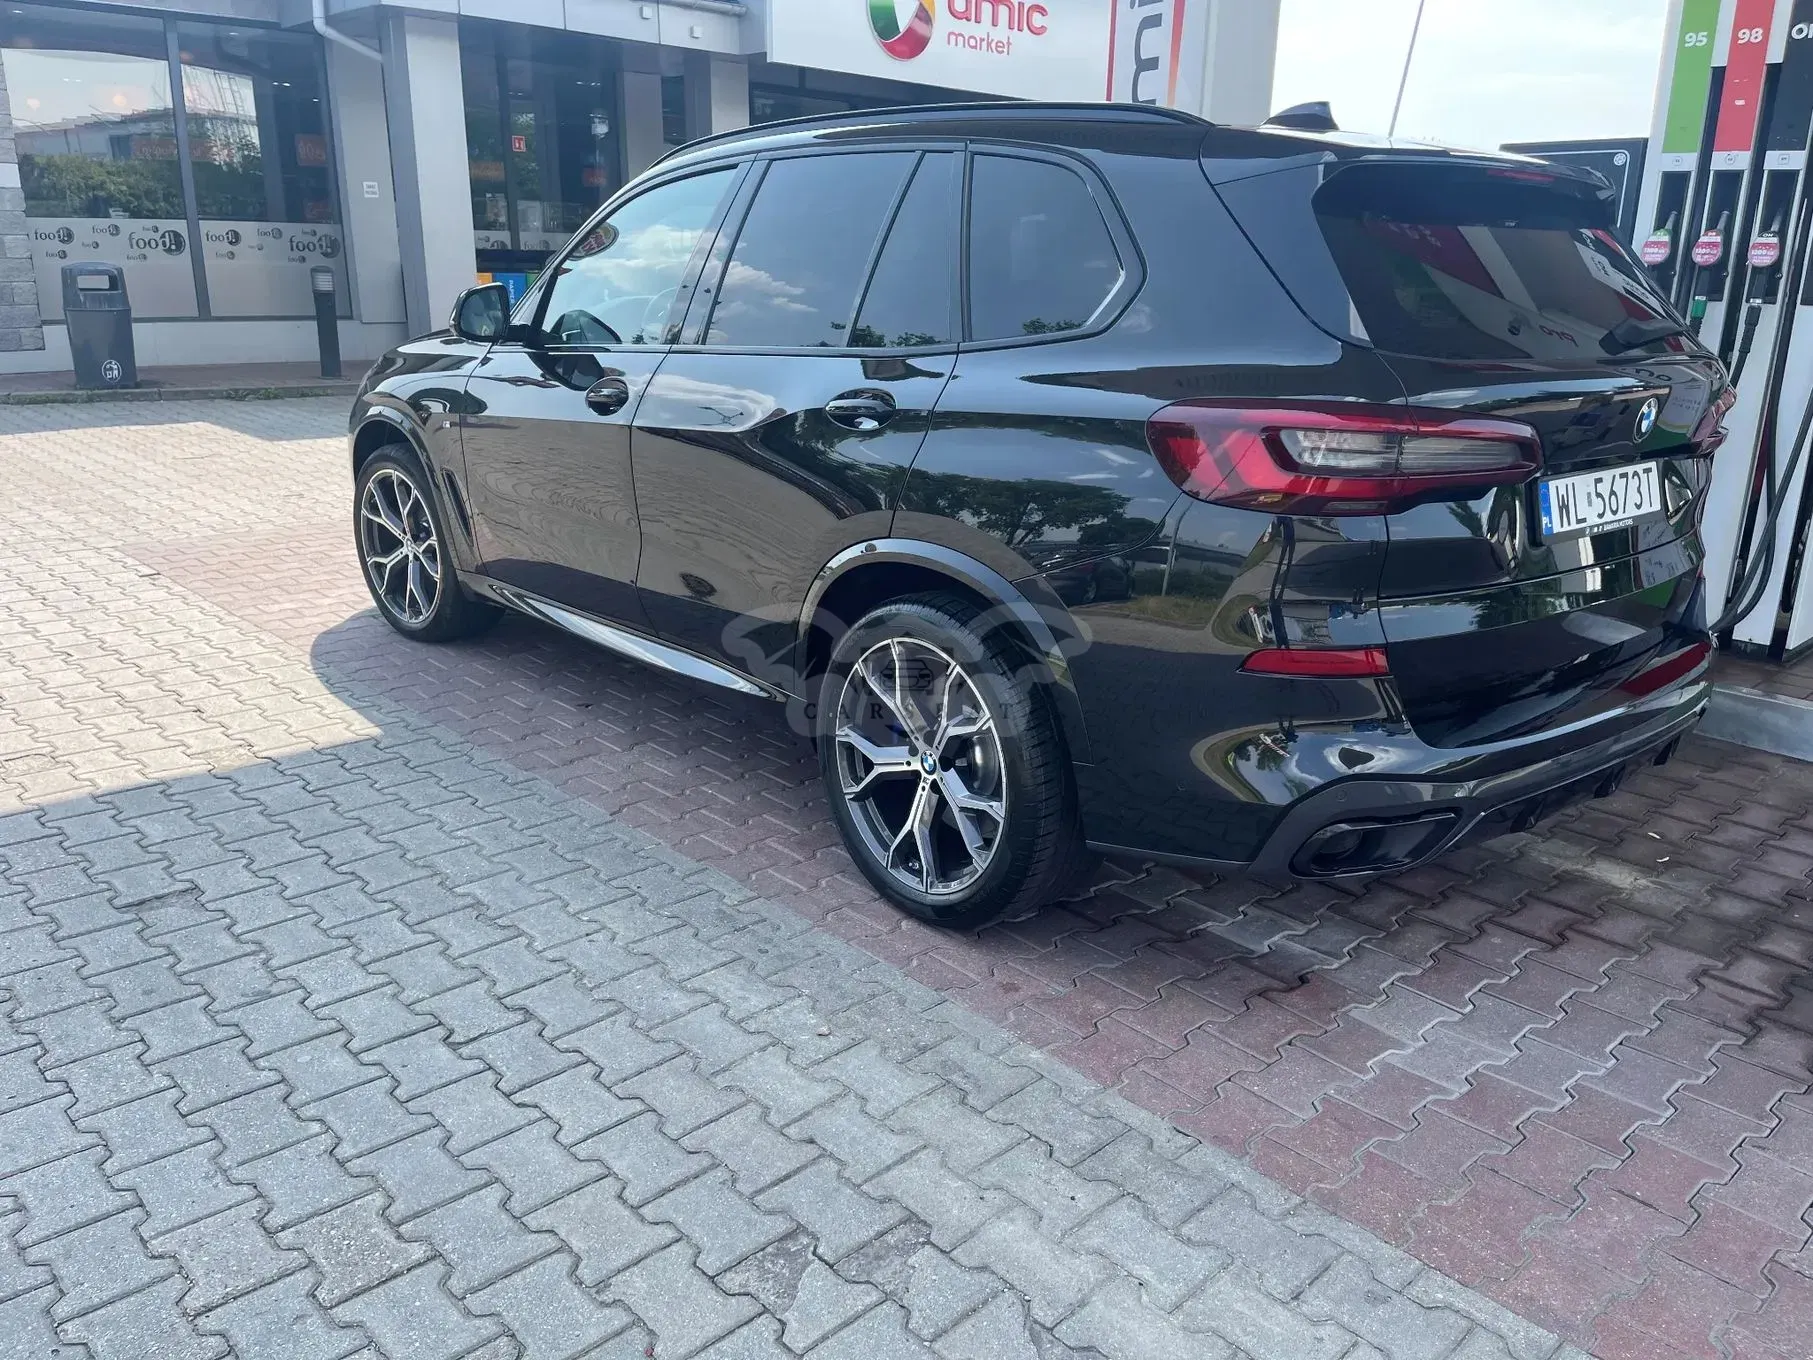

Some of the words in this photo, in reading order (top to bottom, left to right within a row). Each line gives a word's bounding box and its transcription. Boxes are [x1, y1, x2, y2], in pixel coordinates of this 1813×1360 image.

[947, 31, 1012, 56] market
[1684, 32, 1708, 47] 95
[1737, 27, 1763, 44] 98
[1556, 482, 1587, 529] WL
[1594, 467, 1653, 519] 5673T
[1543, 516, 1552, 528] PL
